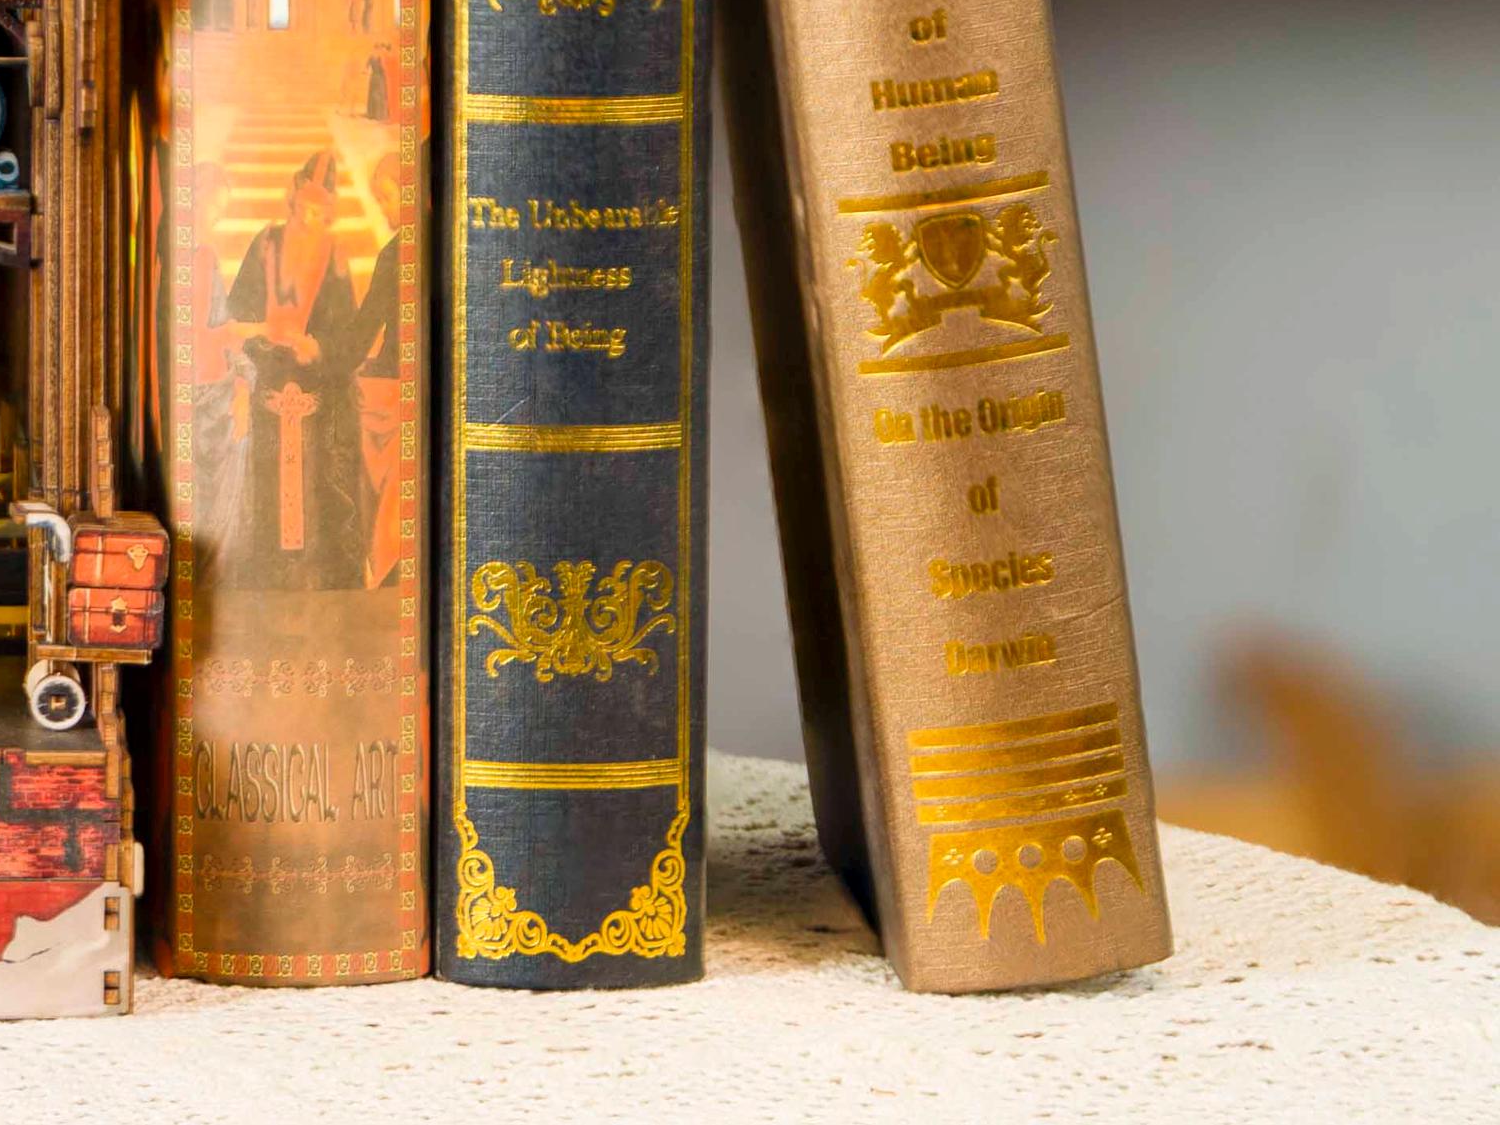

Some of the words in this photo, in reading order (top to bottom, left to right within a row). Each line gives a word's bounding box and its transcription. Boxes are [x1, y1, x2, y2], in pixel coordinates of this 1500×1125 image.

[908, 8, 948, 45] of
[889, 132, 997, 173] Being
[468, 196, 520, 230] The
[508, 319, 540, 351] of
[544, 320, 628, 358] Being
[918, 402, 972, 444] the
[967, 476, 999, 516] of
[196, 740, 339, 823] CLASSICAL
[351, 740, 400, 821] ART
